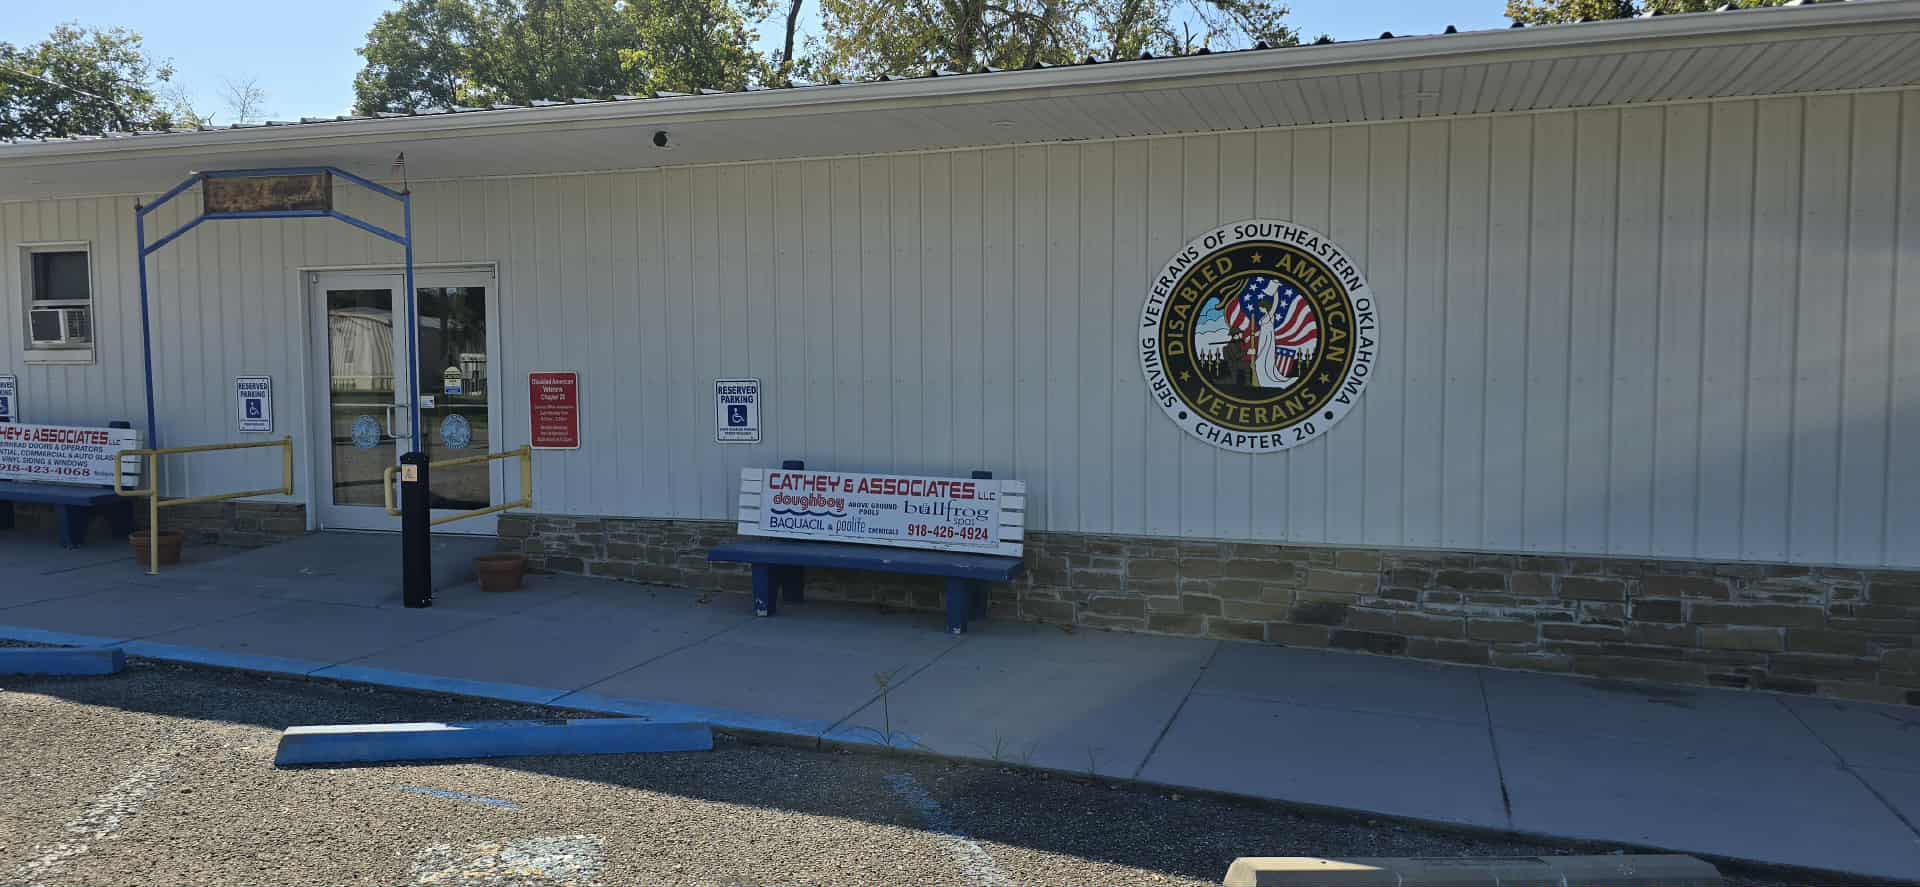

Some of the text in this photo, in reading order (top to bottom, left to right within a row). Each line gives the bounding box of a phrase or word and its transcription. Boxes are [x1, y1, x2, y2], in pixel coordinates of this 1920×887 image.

[1143, 223, 1374, 408] SERVING VETERANS OF SOUTHEASTERN OKLAHOMA
[1168, 254, 1346, 363] DISABLED AMERICAN
[239, 382, 268, 390] RESERVED
[718, 385, 757, 395] RESERVED
[240, 390, 266, 398] PARKING
[720, 395, 754, 404] PARKING
[1196, 387, 1317, 424] VETERANS
[24, 429, 30, 440] &
[32, 428, 108, 445] ASSOCIATES
[1195, 422, 1316, 449] CHAPTER 20
[20, 450, 66, 459] COMMERCIAL
[28, 442, 53, 450] DOORS
[61, 444, 103, 453] OPERATORS
[2, 455, 21, 464] VINYL
[22, 457, 46, 465] SIDING
[54, 459, 88, 468] WINDOWS
[0, 463, 90, 477] 918-423-4068
[769, 472, 996, 500] CATHEY & ASSOCIATES LLC
[773, 491, 845, 513] doughboy
[848, 501, 898, 511] ABOVE GROUND
[858, 508, 880, 516] POOLS
[904, 499, 989, 522] bullfrog
[769, 516, 825, 531] BAQUACIL
[907, 523, 989, 541] 918-426-4924
